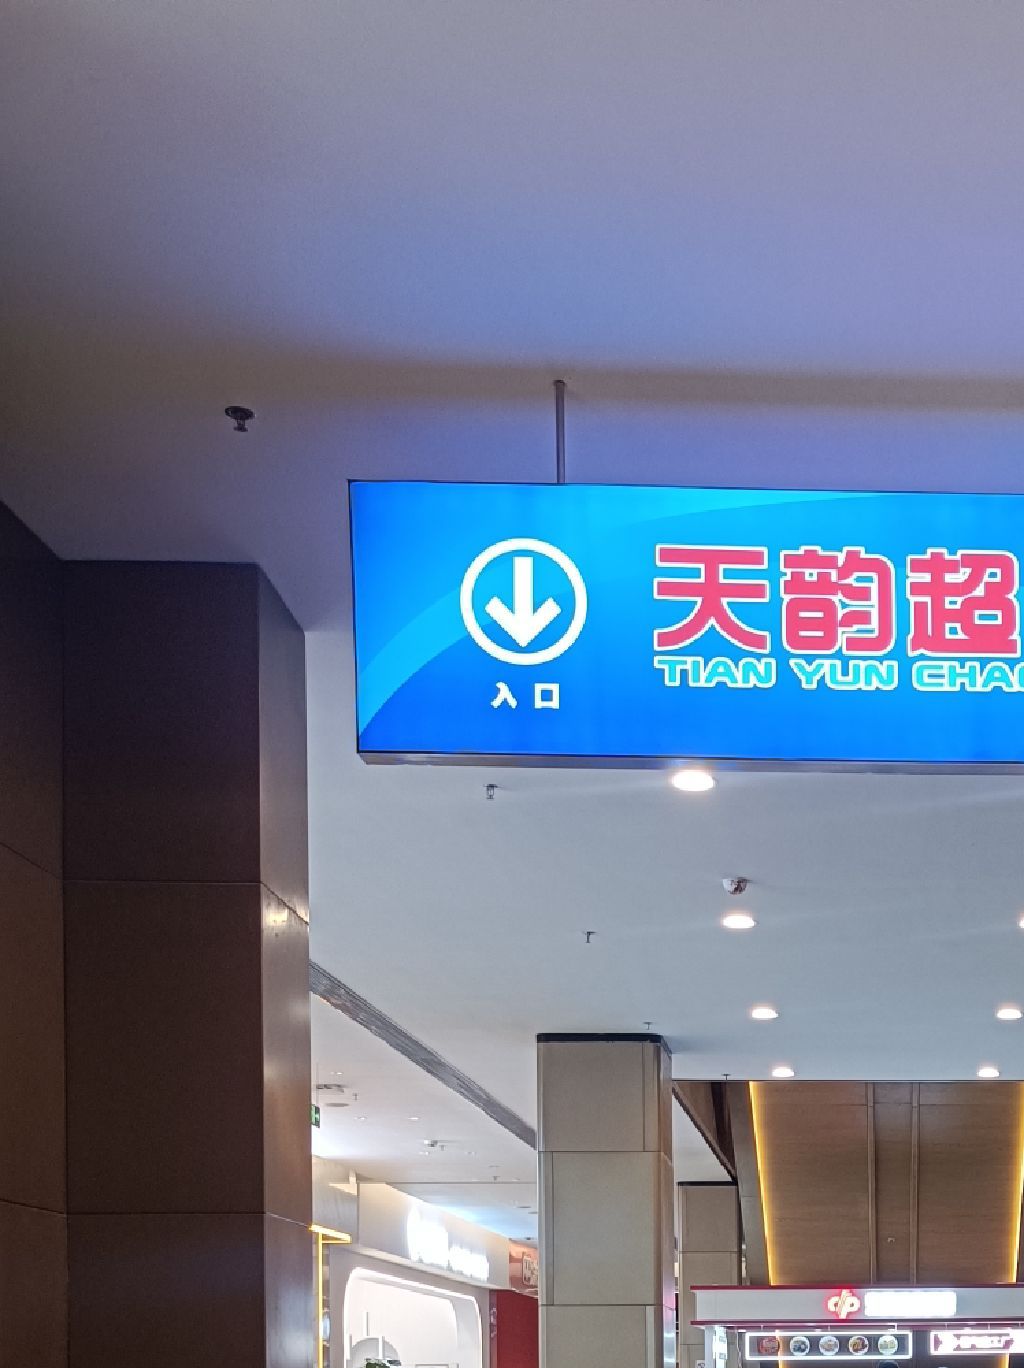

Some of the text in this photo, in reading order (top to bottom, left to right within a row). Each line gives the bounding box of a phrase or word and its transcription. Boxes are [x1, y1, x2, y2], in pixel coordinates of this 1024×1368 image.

[654, 656, 776, 688] TIAN
[788, 658, 899, 691] YUN
[490, 681, 560, 709] 入口
